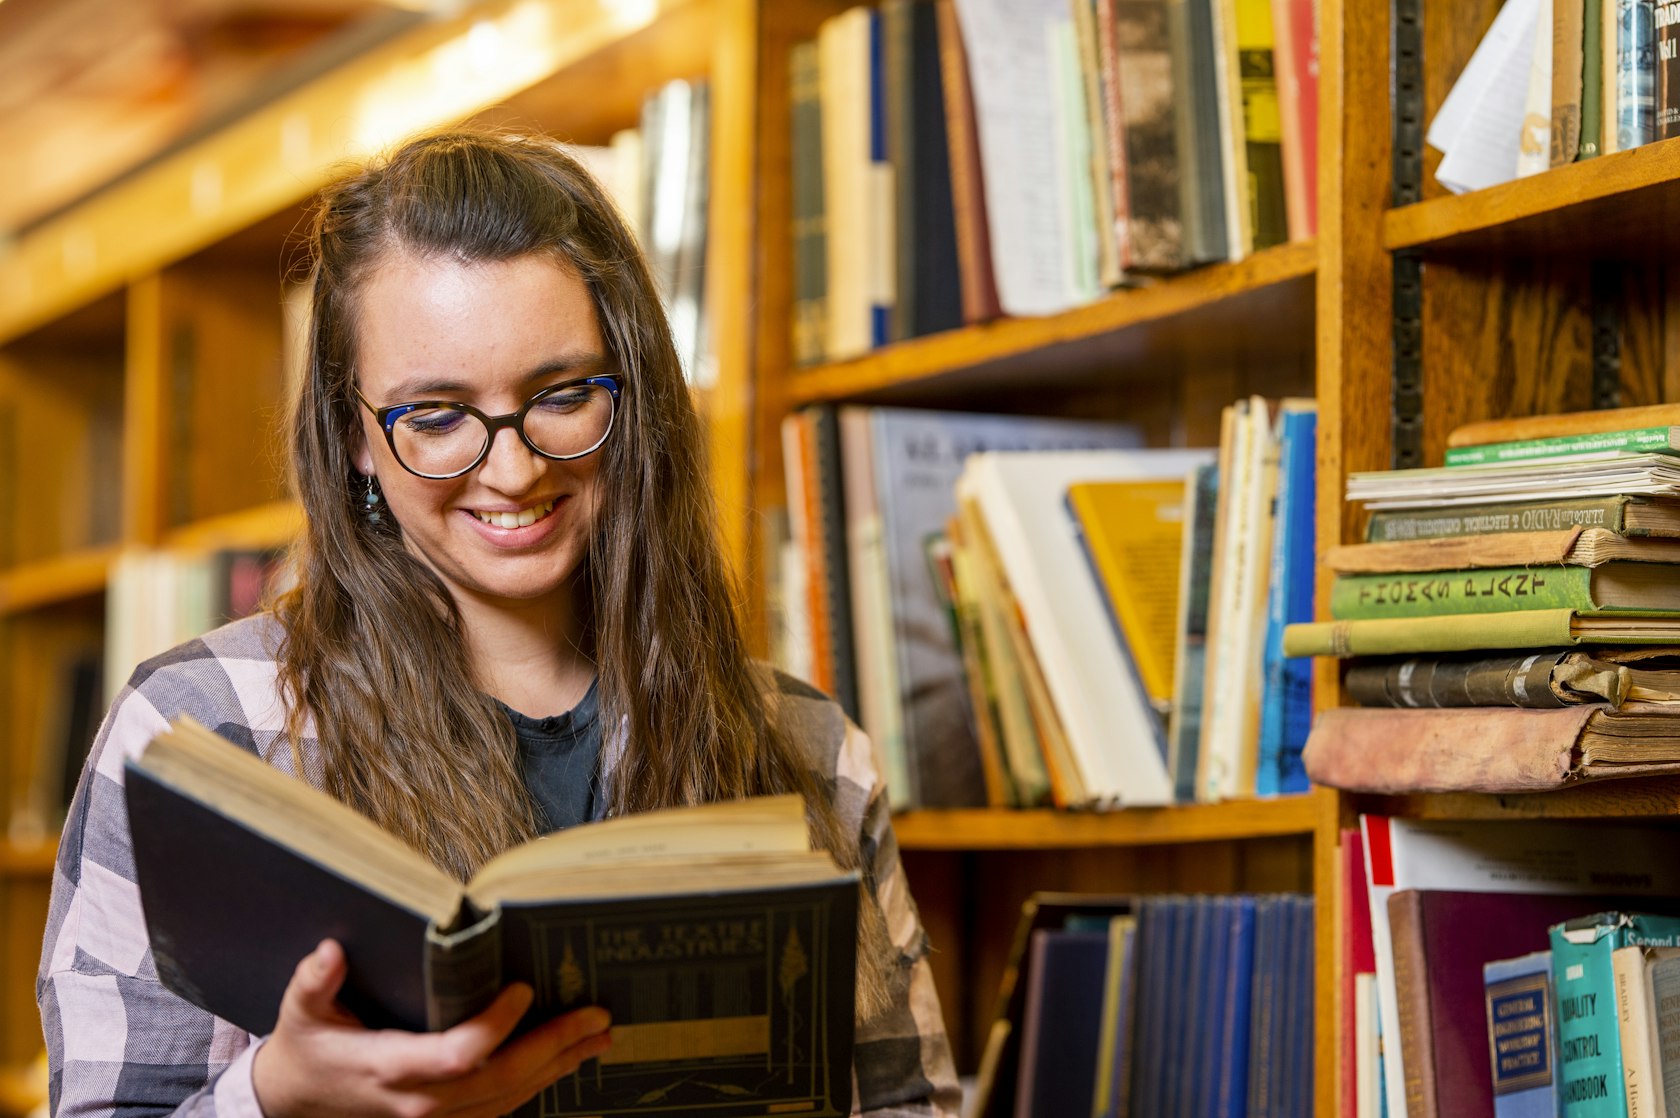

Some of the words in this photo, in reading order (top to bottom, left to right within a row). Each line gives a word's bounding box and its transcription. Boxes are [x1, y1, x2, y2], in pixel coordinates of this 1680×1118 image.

[1464, 514, 1511, 533] ELECTRICAL
[1512, 513, 1520, 529] &
[1522, 508, 1561, 530] RADIO
[1358, 579, 1450, 605] THOMAS
[1464, 573, 1546, 598] PLANT
[1498, 998, 1536, 1017] GENERAL
[1618, 973, 1632, 1024] BRADLEY
[1501, 1051, 1540, 1072] PRACTICE
[1627, 1067, 1636, 1079] A
